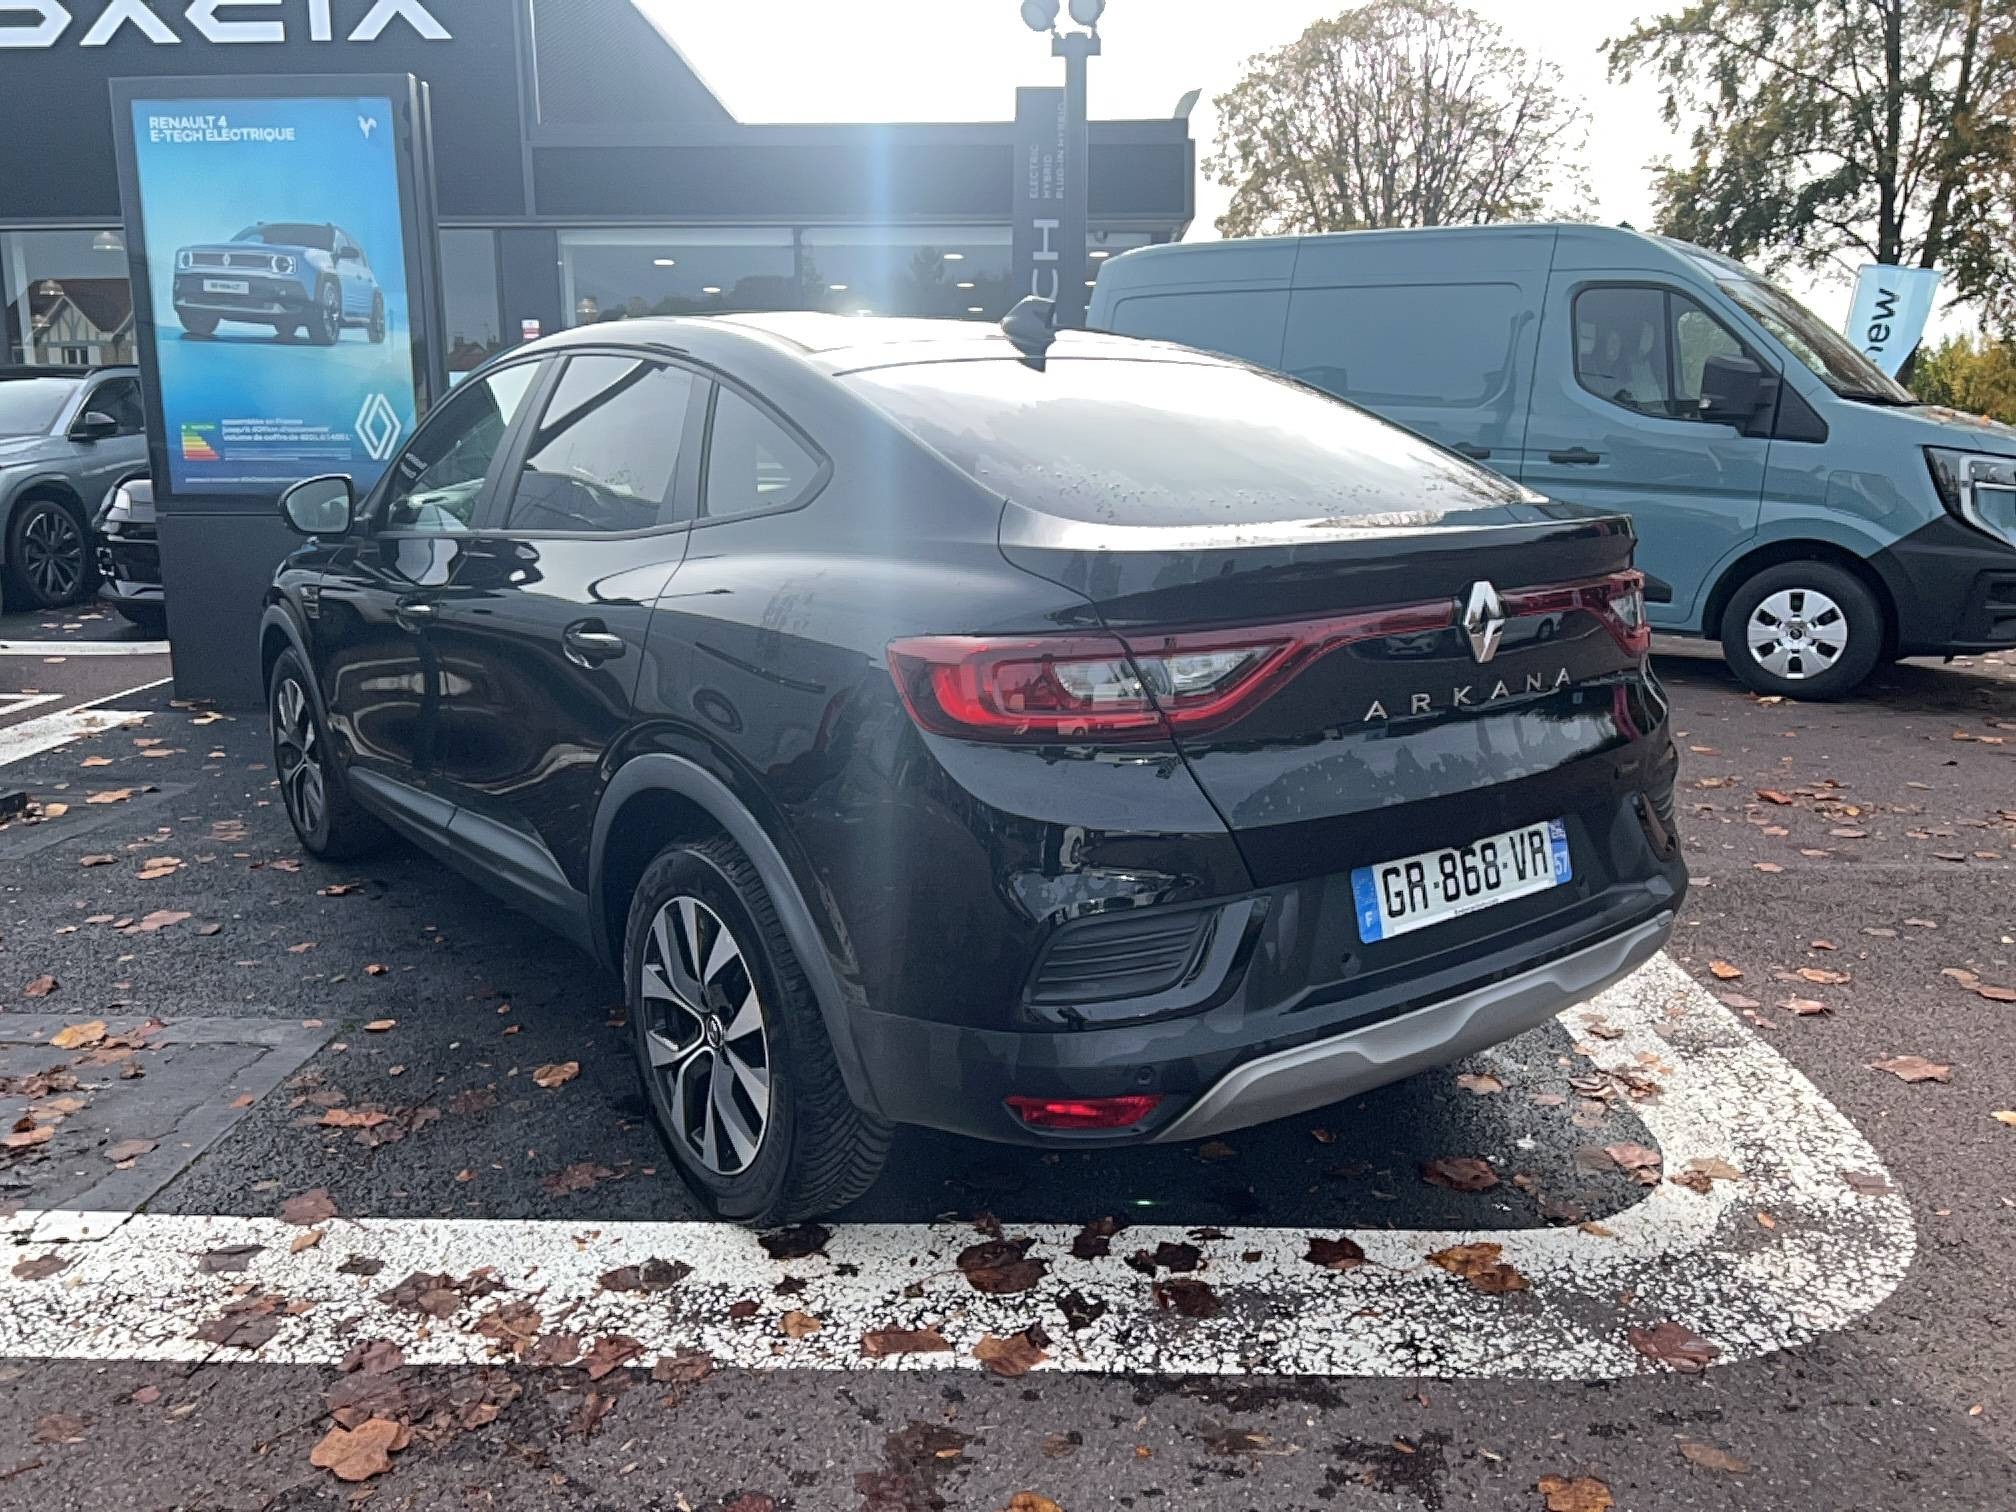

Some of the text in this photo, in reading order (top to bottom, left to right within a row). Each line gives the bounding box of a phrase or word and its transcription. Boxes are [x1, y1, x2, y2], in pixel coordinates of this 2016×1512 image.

[149, 115, 228, 129] RENAULT 4
[150, 130, 203, 143] E-TECH
[1029, 144, 1040, 199] ELECTRIC
[1043, 154, 1053, 199] HYBRID
[1363, 667, 1572, 722] ARKANA
[1382, 829, 1548, 918] GR-868-VR
[1554, 850, 1569, 876] 57
[1364, 911, 1373, 928] F
